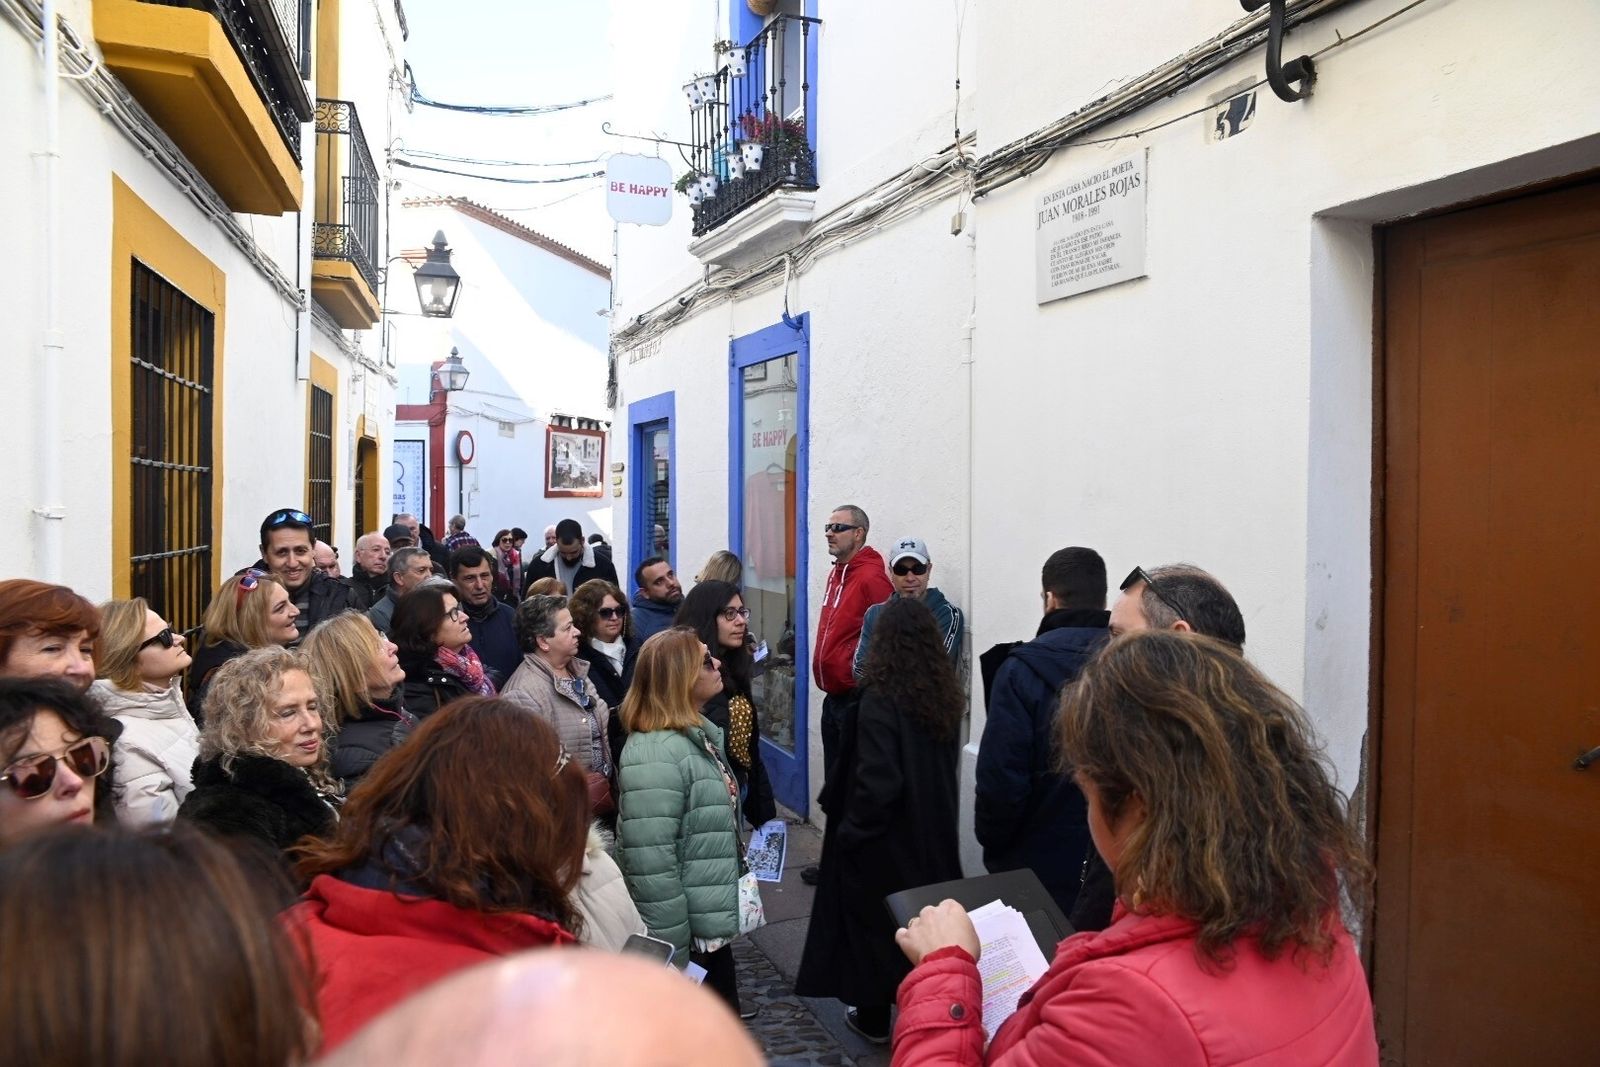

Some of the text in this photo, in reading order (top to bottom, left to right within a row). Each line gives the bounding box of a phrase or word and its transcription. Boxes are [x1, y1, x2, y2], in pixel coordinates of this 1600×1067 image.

[610, 181, 668, 198] BE HAPPY
[1043, 196, 1051, 205] EN
[1052, 190, 1065, 202] ESTA
[1066, 183, 1081, 196] CASA
[1102, 169, 1110, 180] EL
[1111, 160, 1133, 174] POETA
[1037, 172, 1140, 230] JUAN MORALES ROJAS
[752, 430, 788, 448] BE HAPPY
